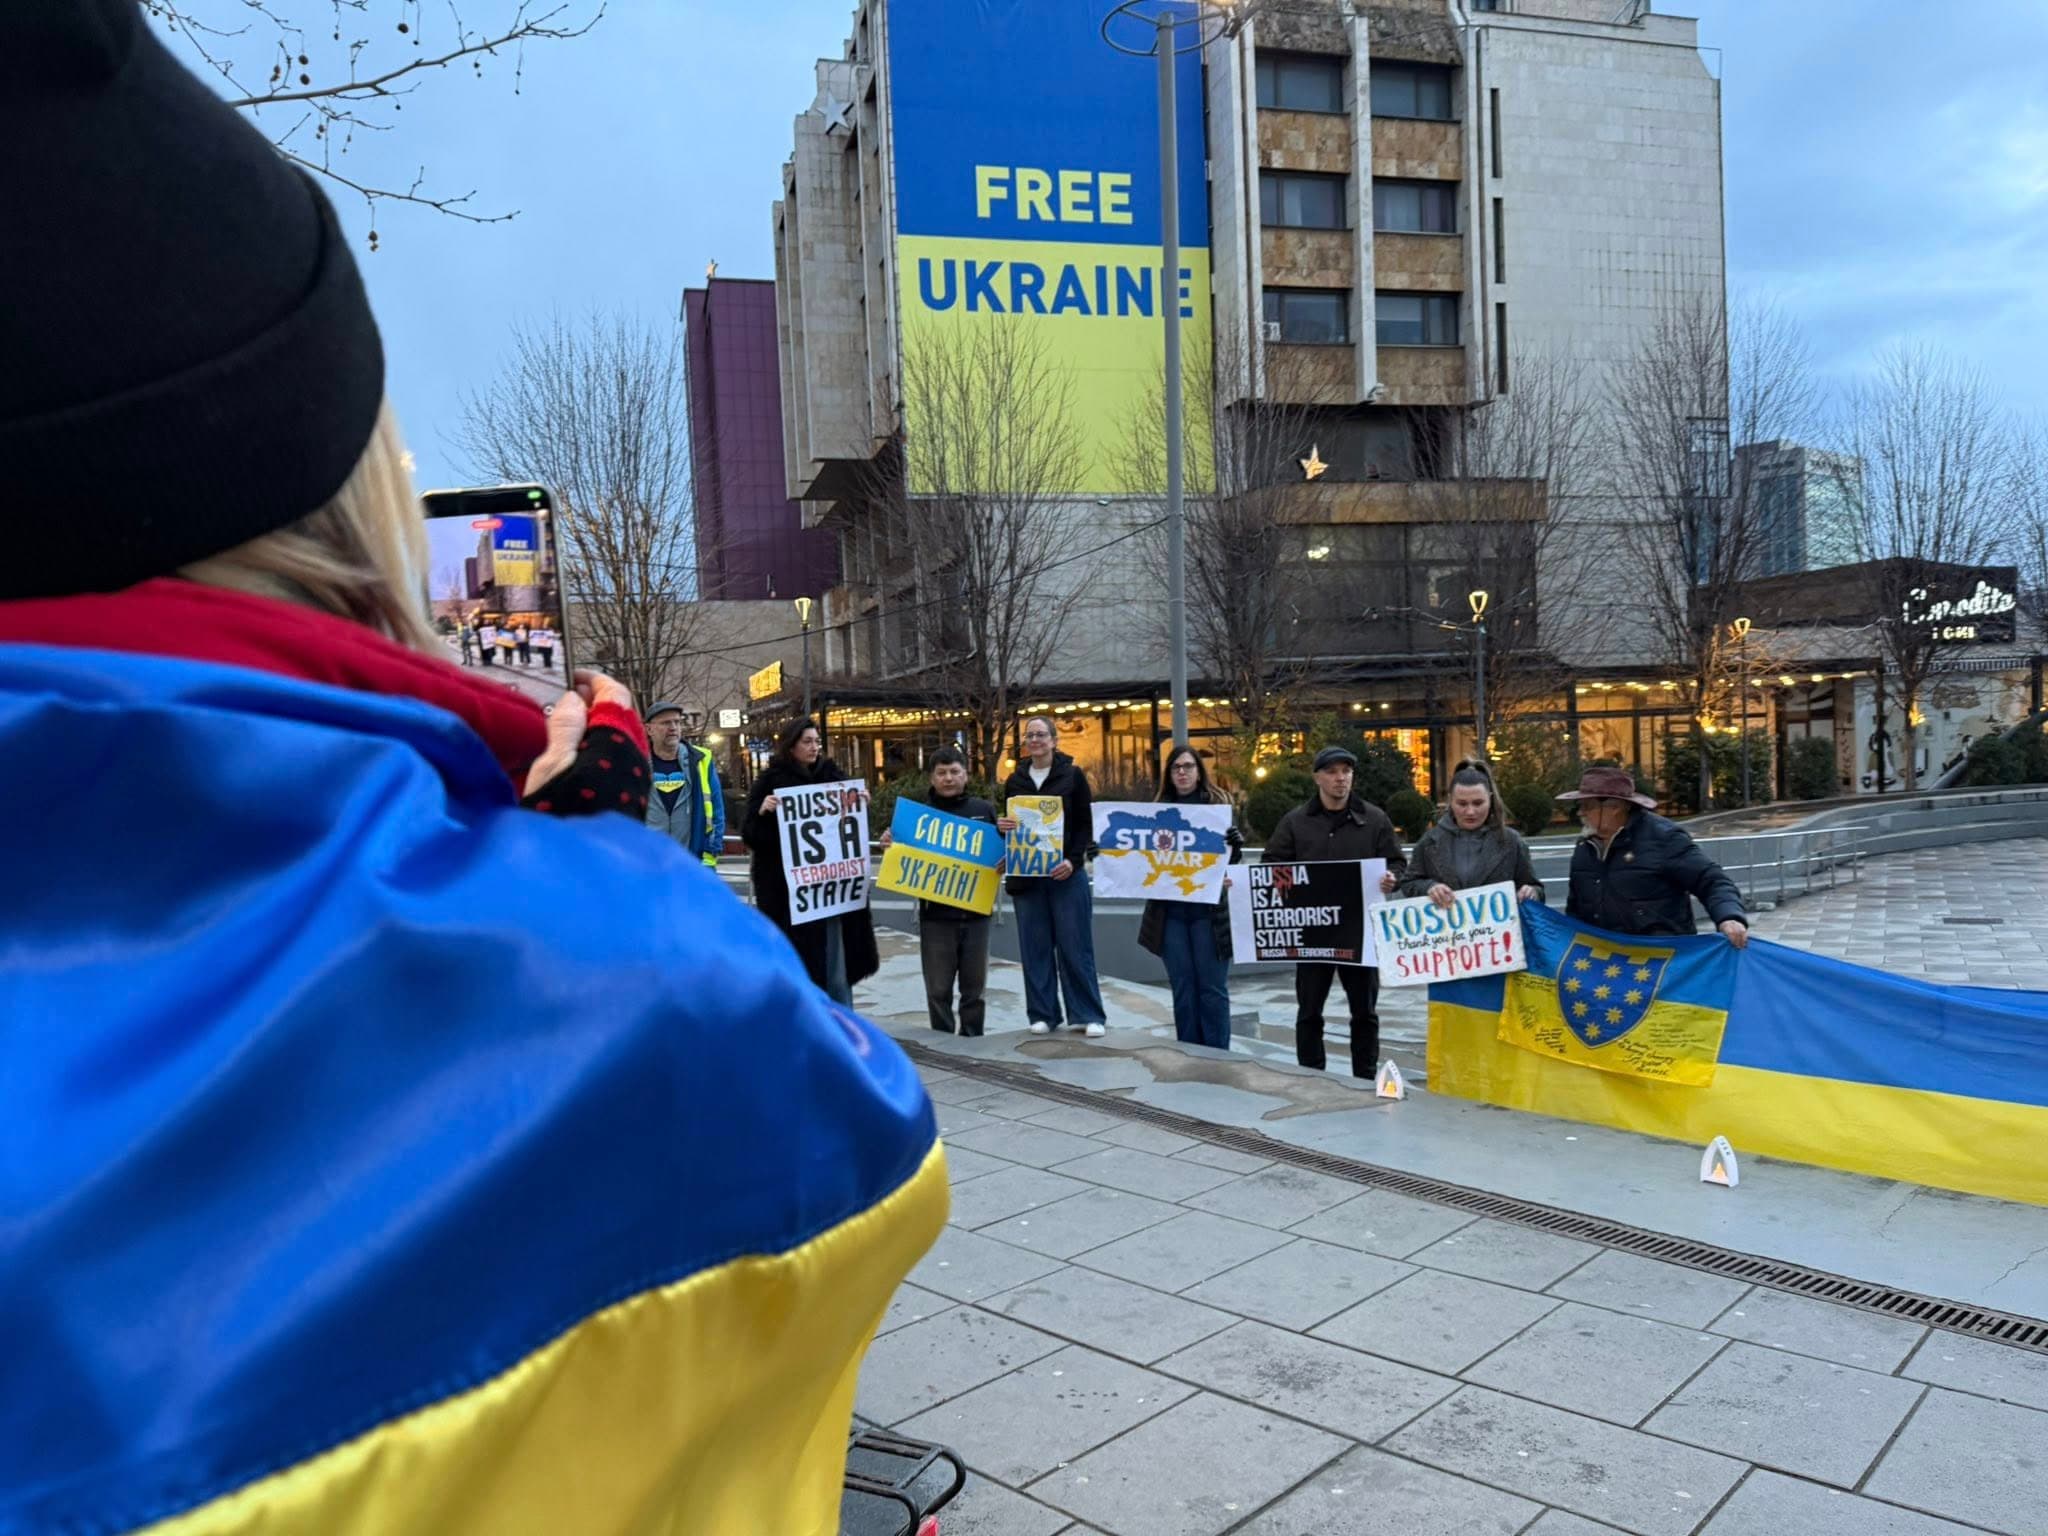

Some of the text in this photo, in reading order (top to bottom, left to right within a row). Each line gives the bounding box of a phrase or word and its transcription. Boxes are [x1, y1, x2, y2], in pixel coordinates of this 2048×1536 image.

[975, 165, 1133, 225] FREE
[780, 788, 861, 822] RUSSIA
[788, 815, 861, 867] IS A
[914, 813, 984, 857] СЛАВА
[1115, 828, 1196, 851] STOP
[1153, 850, 1204, 867] WAR
[791, 858, 866, 885] TERRORIST
[895, 855, 980, 903] УКРАЇНІ
[1250, 865, 1310, 888] RUSSIA
[796, 876, 865, 913] STATE
[1252, 887, 1284, 908] IS A
[1253, 906, 1342, 929] TERRORIST
[1255, 928, 1304, 948] STATE
[1397, 926, 1496, 950] thank you for your
